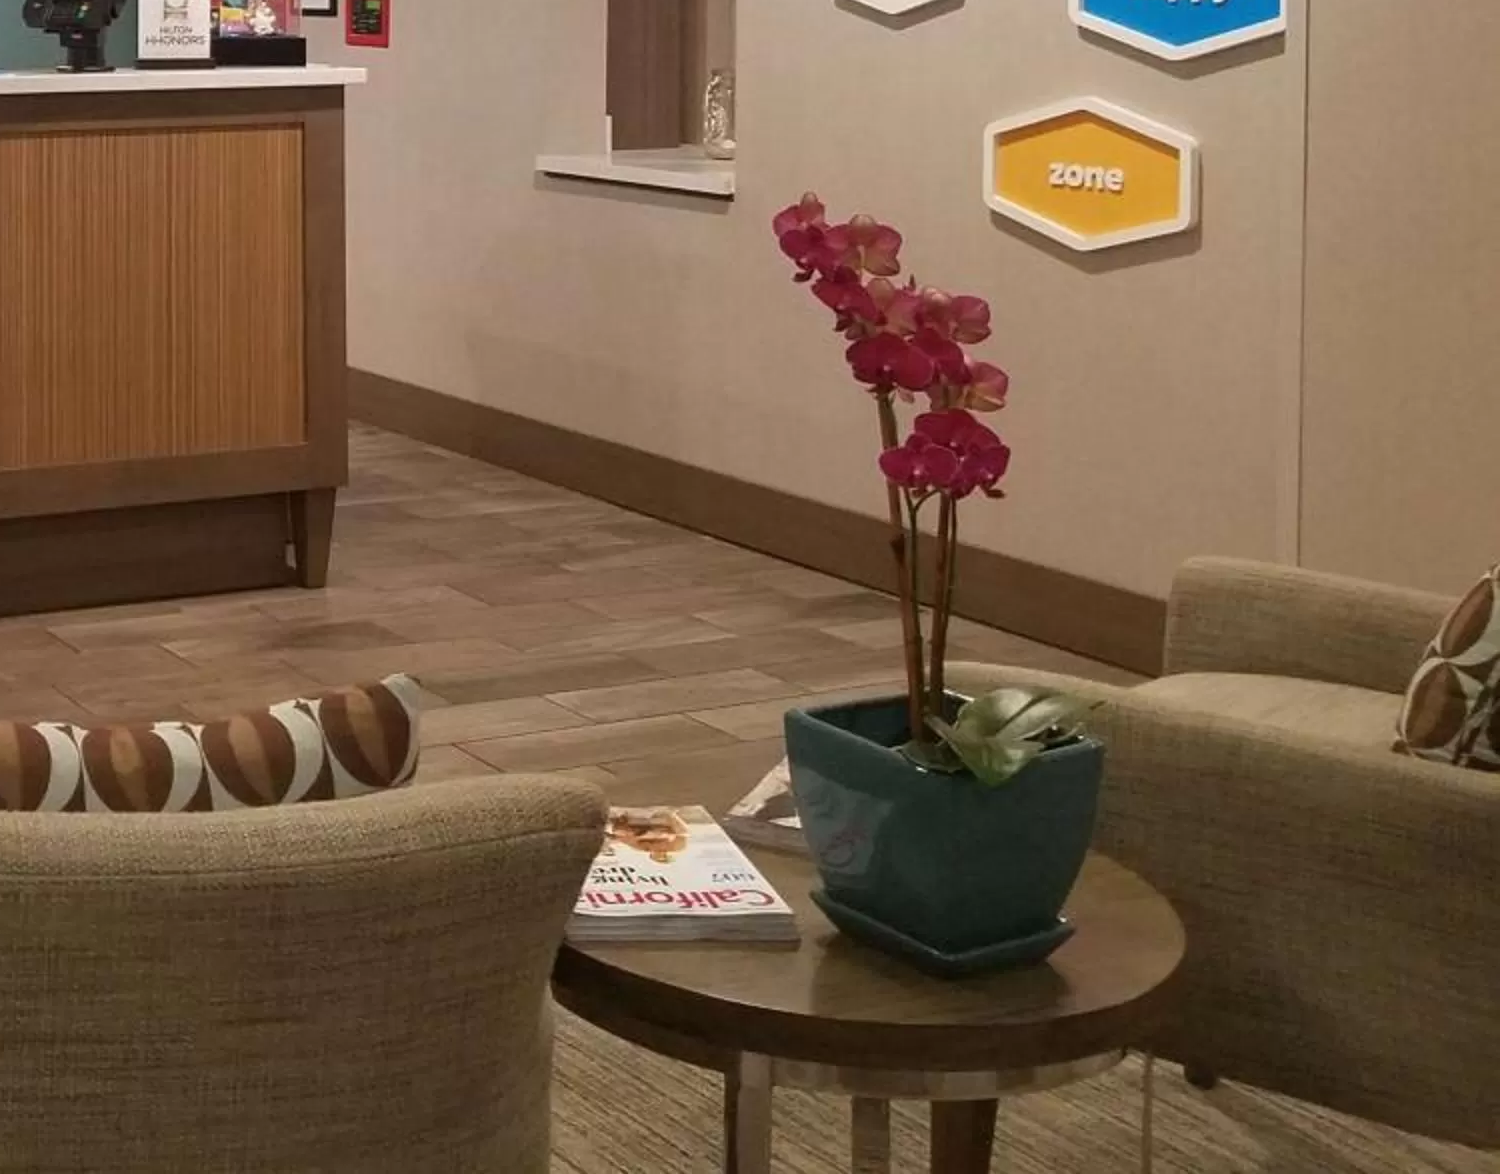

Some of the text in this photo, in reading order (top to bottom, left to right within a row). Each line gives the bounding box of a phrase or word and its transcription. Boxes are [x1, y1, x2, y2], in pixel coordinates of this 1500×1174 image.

[159, 25, 193, 35] HILTON
[145, 35, 207, 46] HHONORS
[1048, 162, 1125, 192] zone
[591, 873, 669, 886] living
[580, 888, 776, 909] Californi
